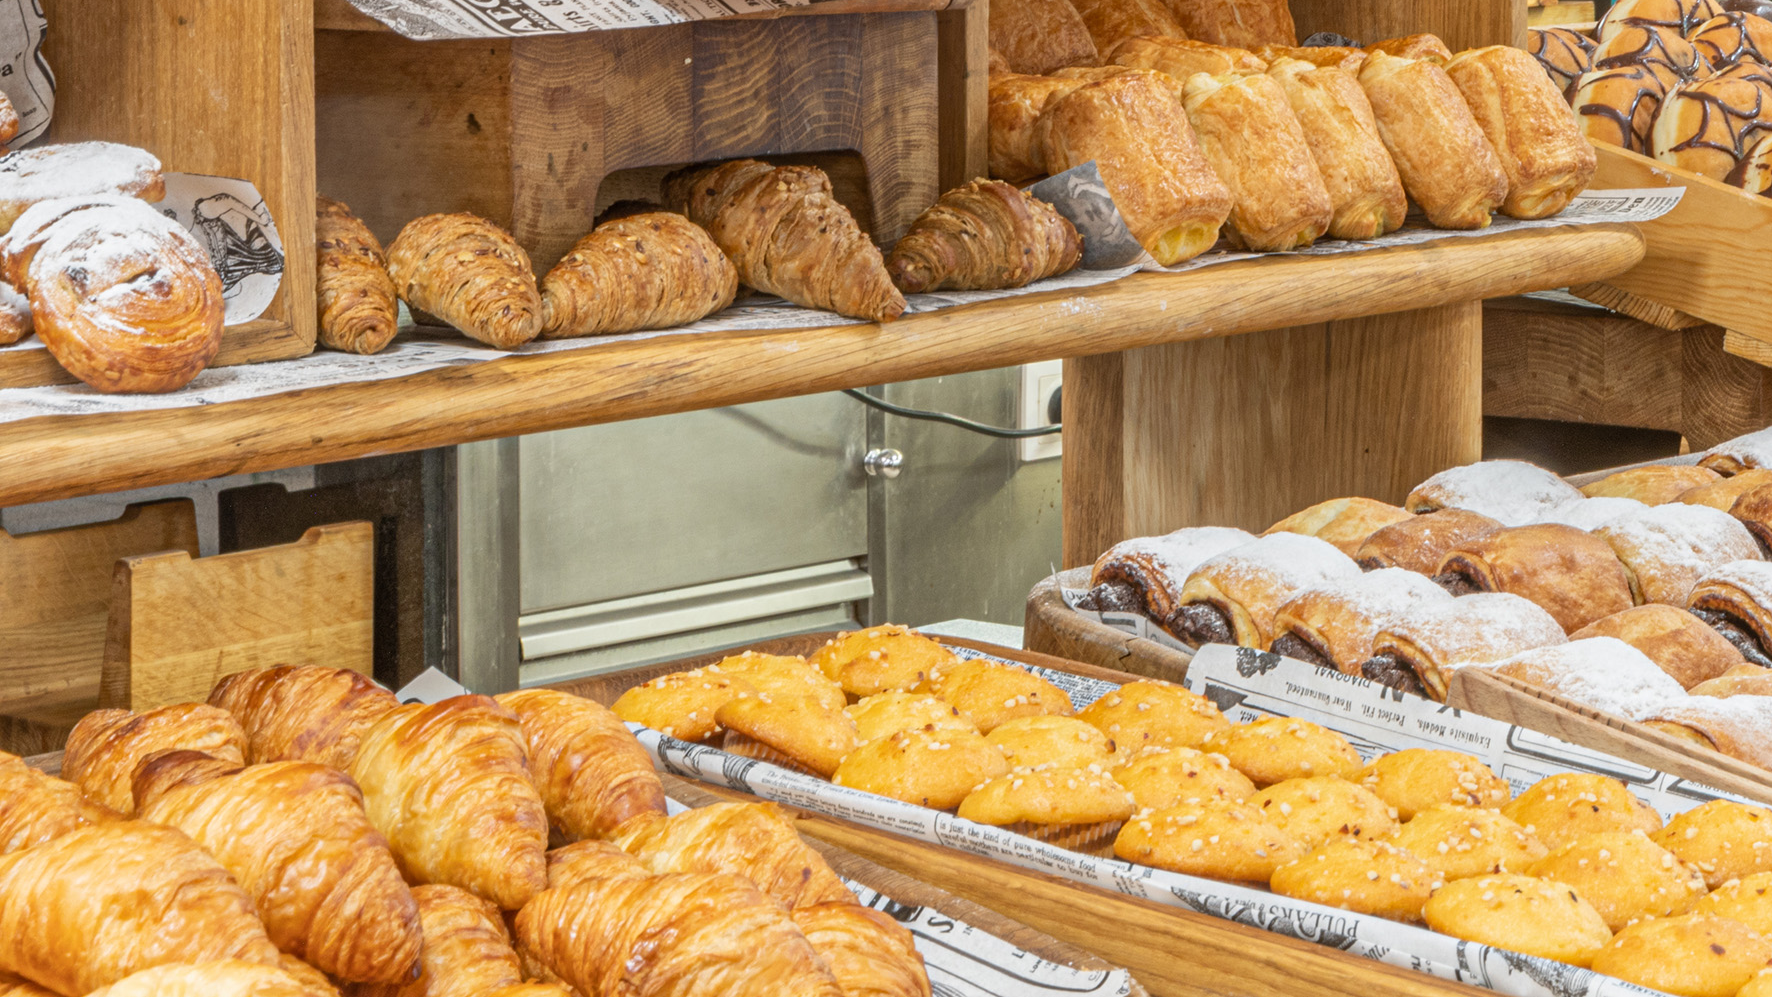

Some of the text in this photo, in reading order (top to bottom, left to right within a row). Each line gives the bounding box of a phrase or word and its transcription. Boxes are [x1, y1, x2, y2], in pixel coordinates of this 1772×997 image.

[1285, 681, 1492, 749] Exquisite Models. Perfect Fit. Wear Guaranteed.
[939, 821, 1097, 873] is just the kind of pure wholesome food
[1270, 902, 1361, 939] PULLARS
